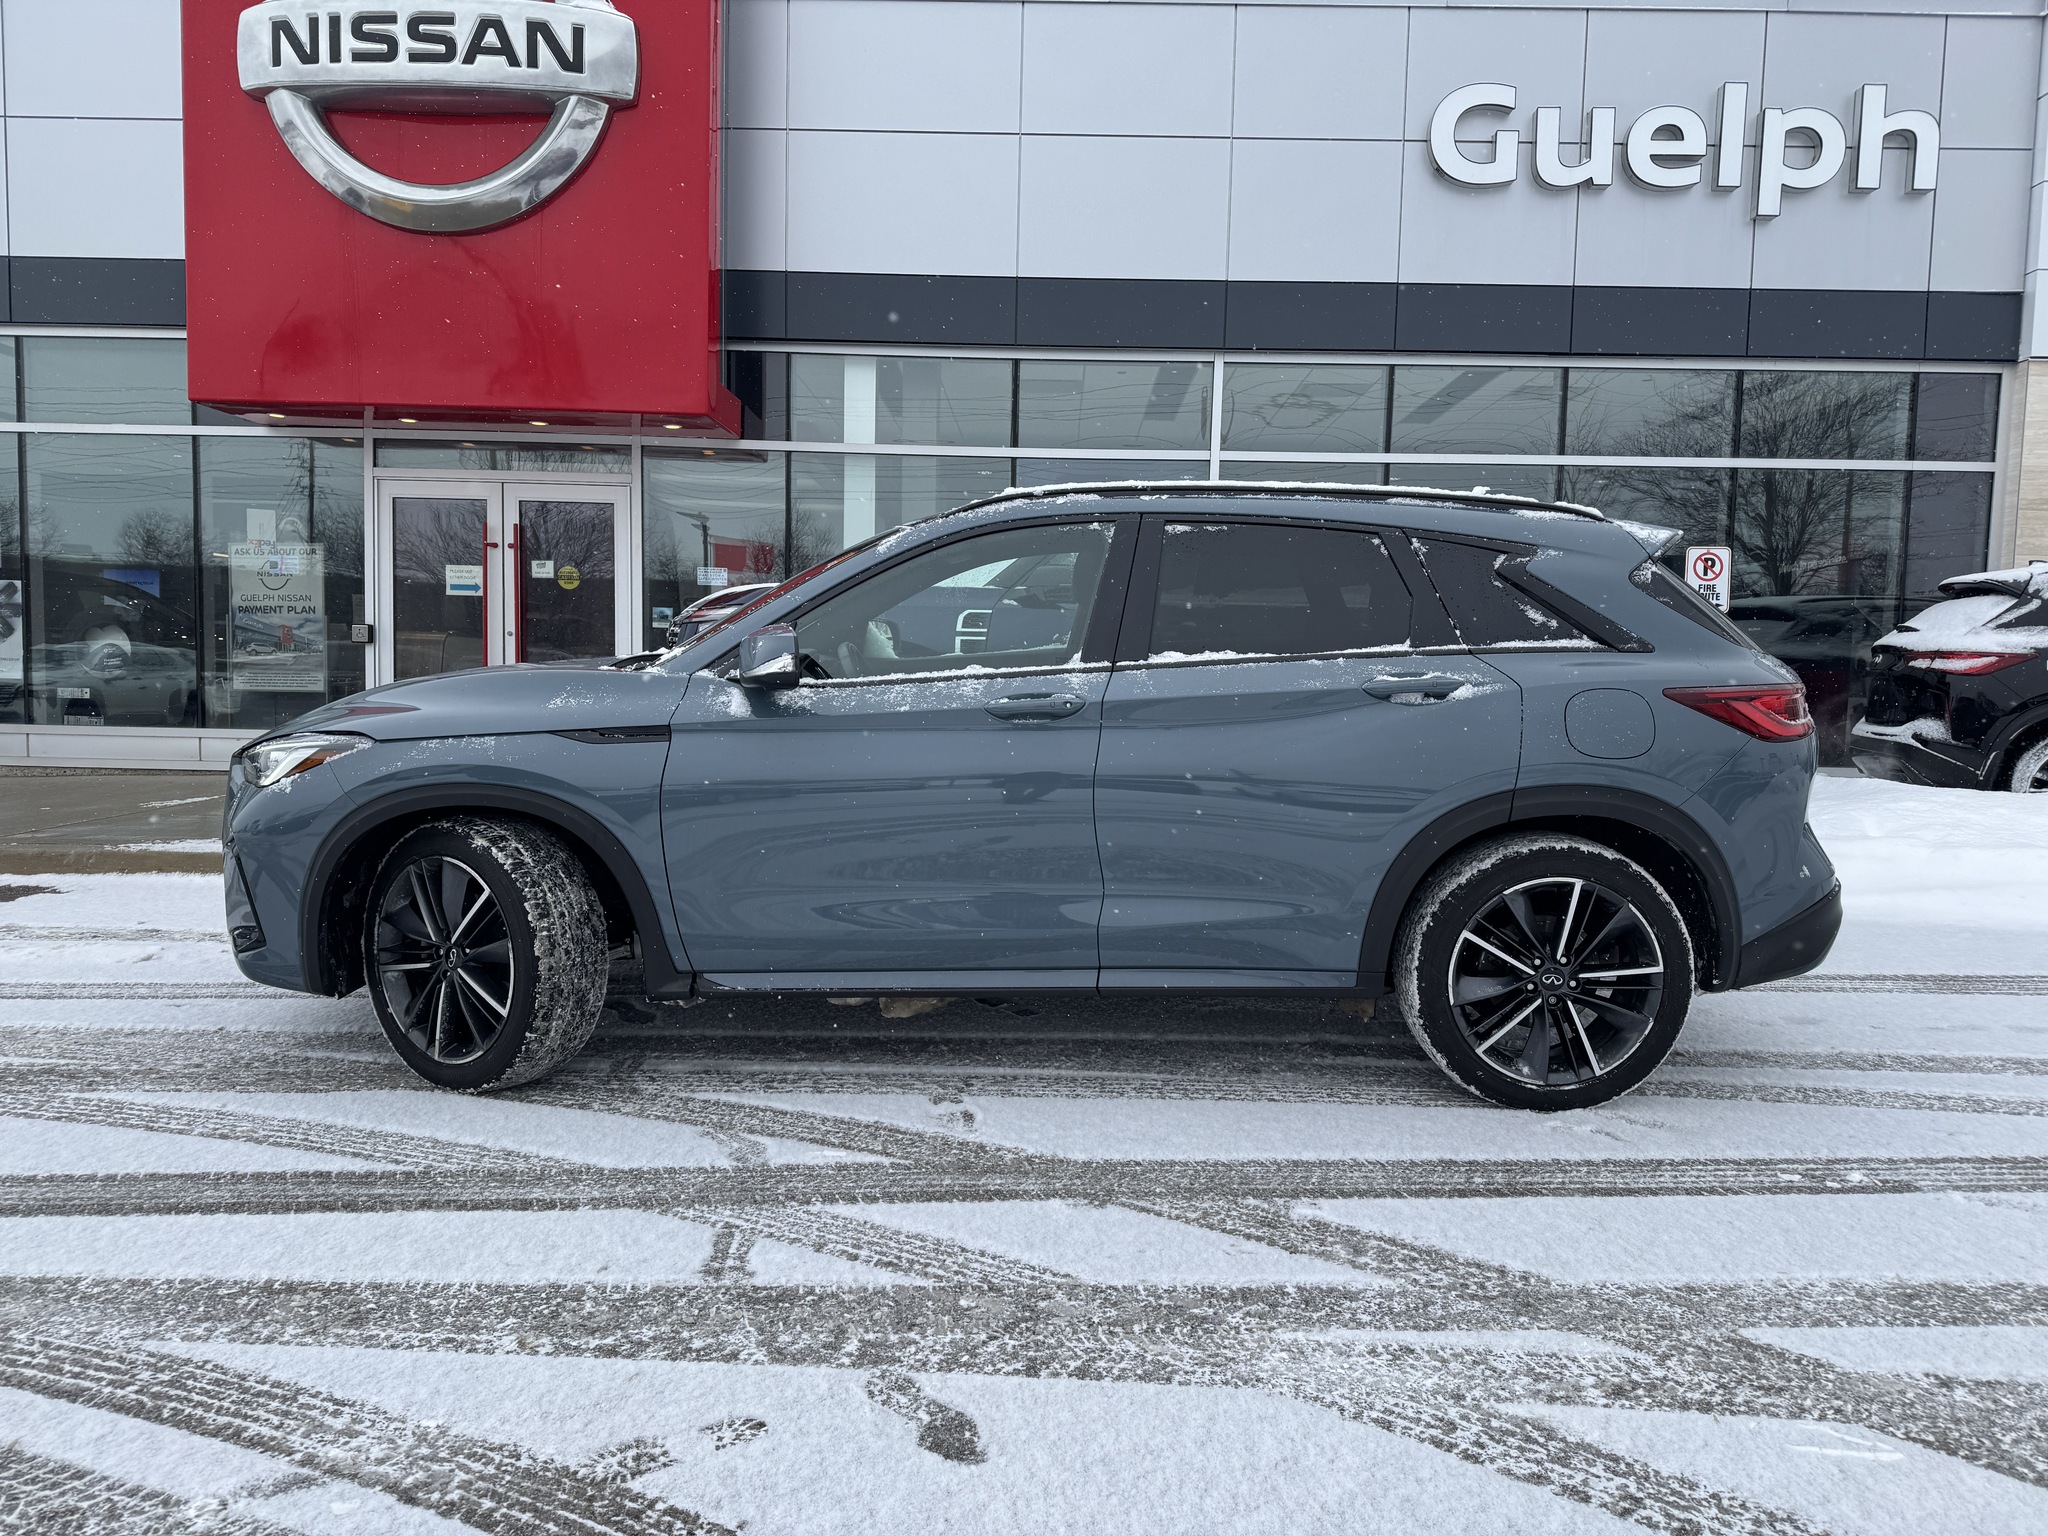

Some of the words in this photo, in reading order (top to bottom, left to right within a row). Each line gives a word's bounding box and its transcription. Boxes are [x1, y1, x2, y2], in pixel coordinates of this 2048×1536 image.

[270, 13, 586, 74] NISSAN
[1428, 81, 1941, 220] Guelph
[234, 548, 250, 556] ASK
[253, 548, 265, 556] US
[267, 548, 296, 556] ABOUT
[1698, 584, 1717, 592] FIRE
[240, 594, 275, 602] GUELPH
[277, 594, 312, 602] NISSAN
[238, 605, 284, 614] PAYMENT
[287, 605, 316, 614] PLAN
